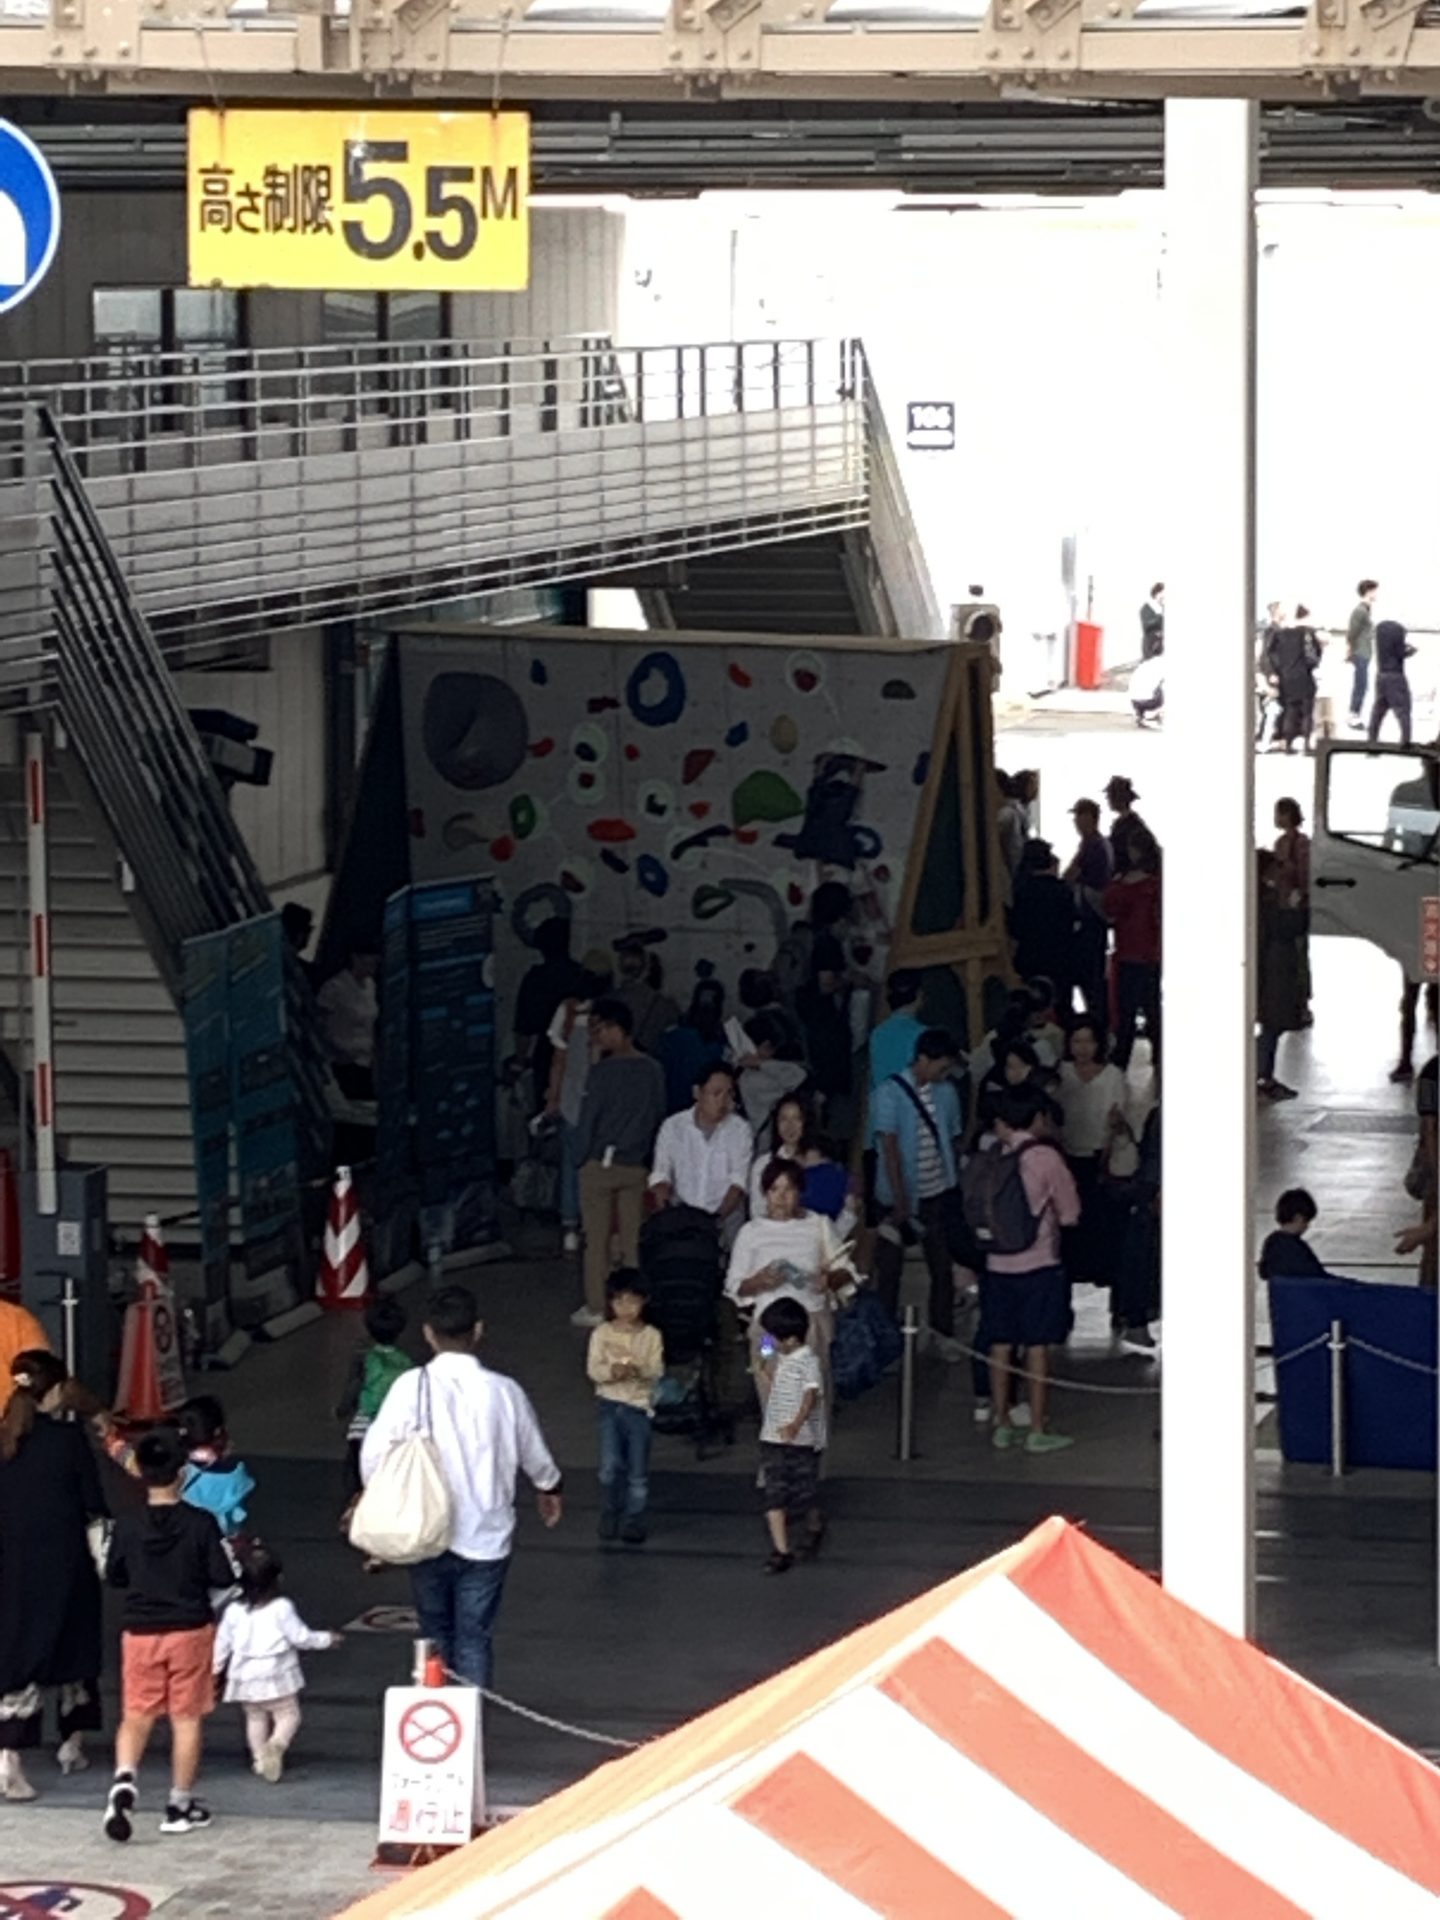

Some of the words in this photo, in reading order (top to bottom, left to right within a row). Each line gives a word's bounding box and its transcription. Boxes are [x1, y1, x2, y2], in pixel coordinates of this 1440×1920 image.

[198, 162, 334, 236] 高さ制限
[341, 139, 518, 262] 5.5M
